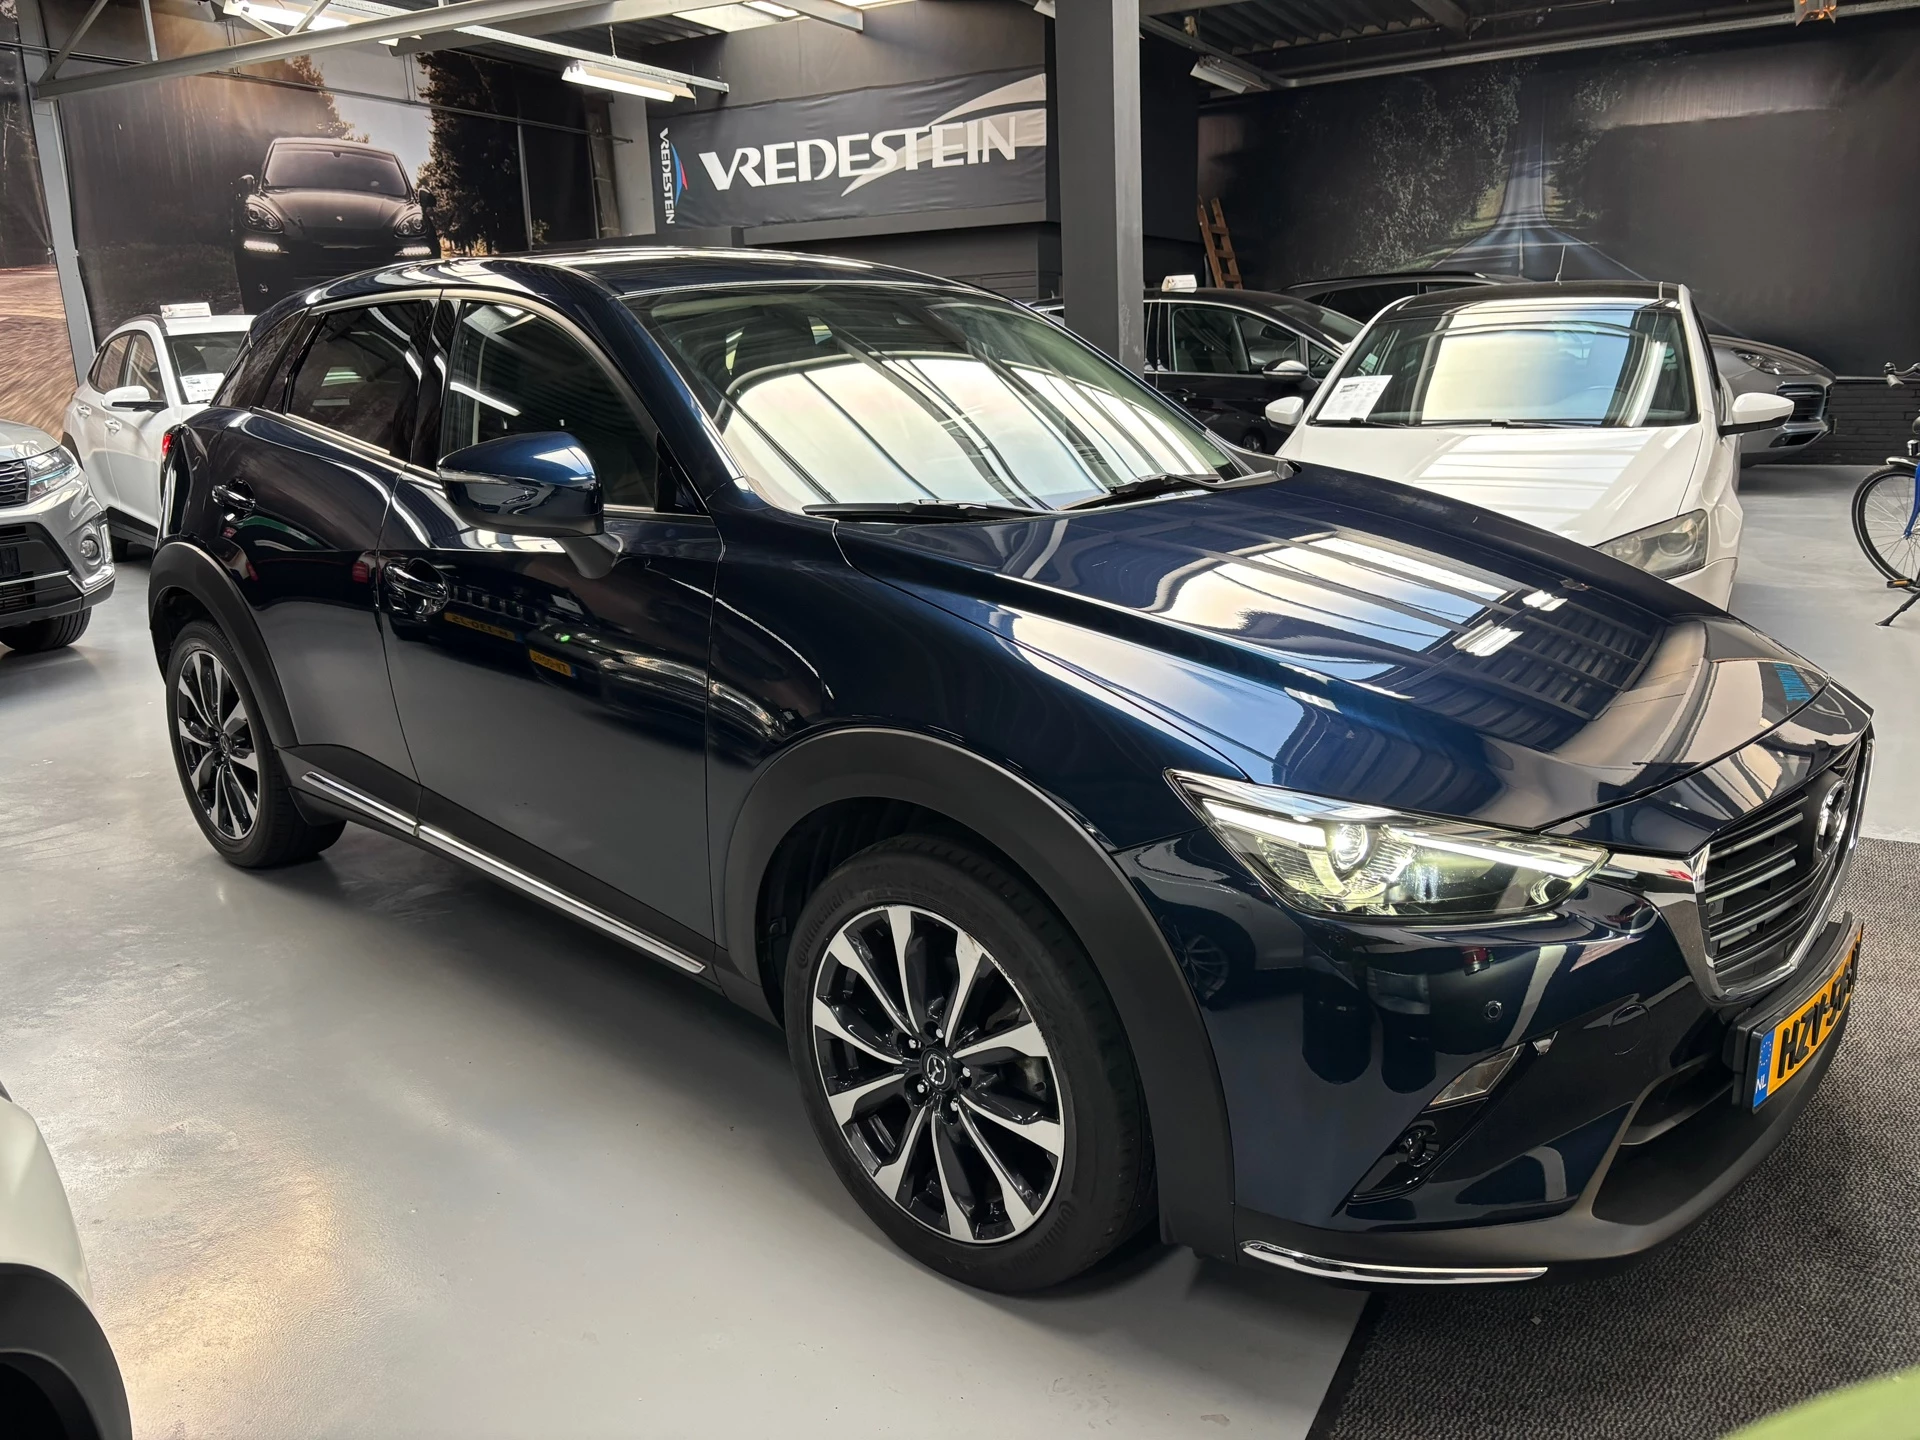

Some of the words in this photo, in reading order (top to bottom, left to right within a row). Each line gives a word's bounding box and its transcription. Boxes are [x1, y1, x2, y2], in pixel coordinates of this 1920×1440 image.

[658, 127, 676, 225] VREDESTEIN
[699, 115, 1016, 197] VREDESTEIN
[1755, 1074, 1767, 1094] NL
